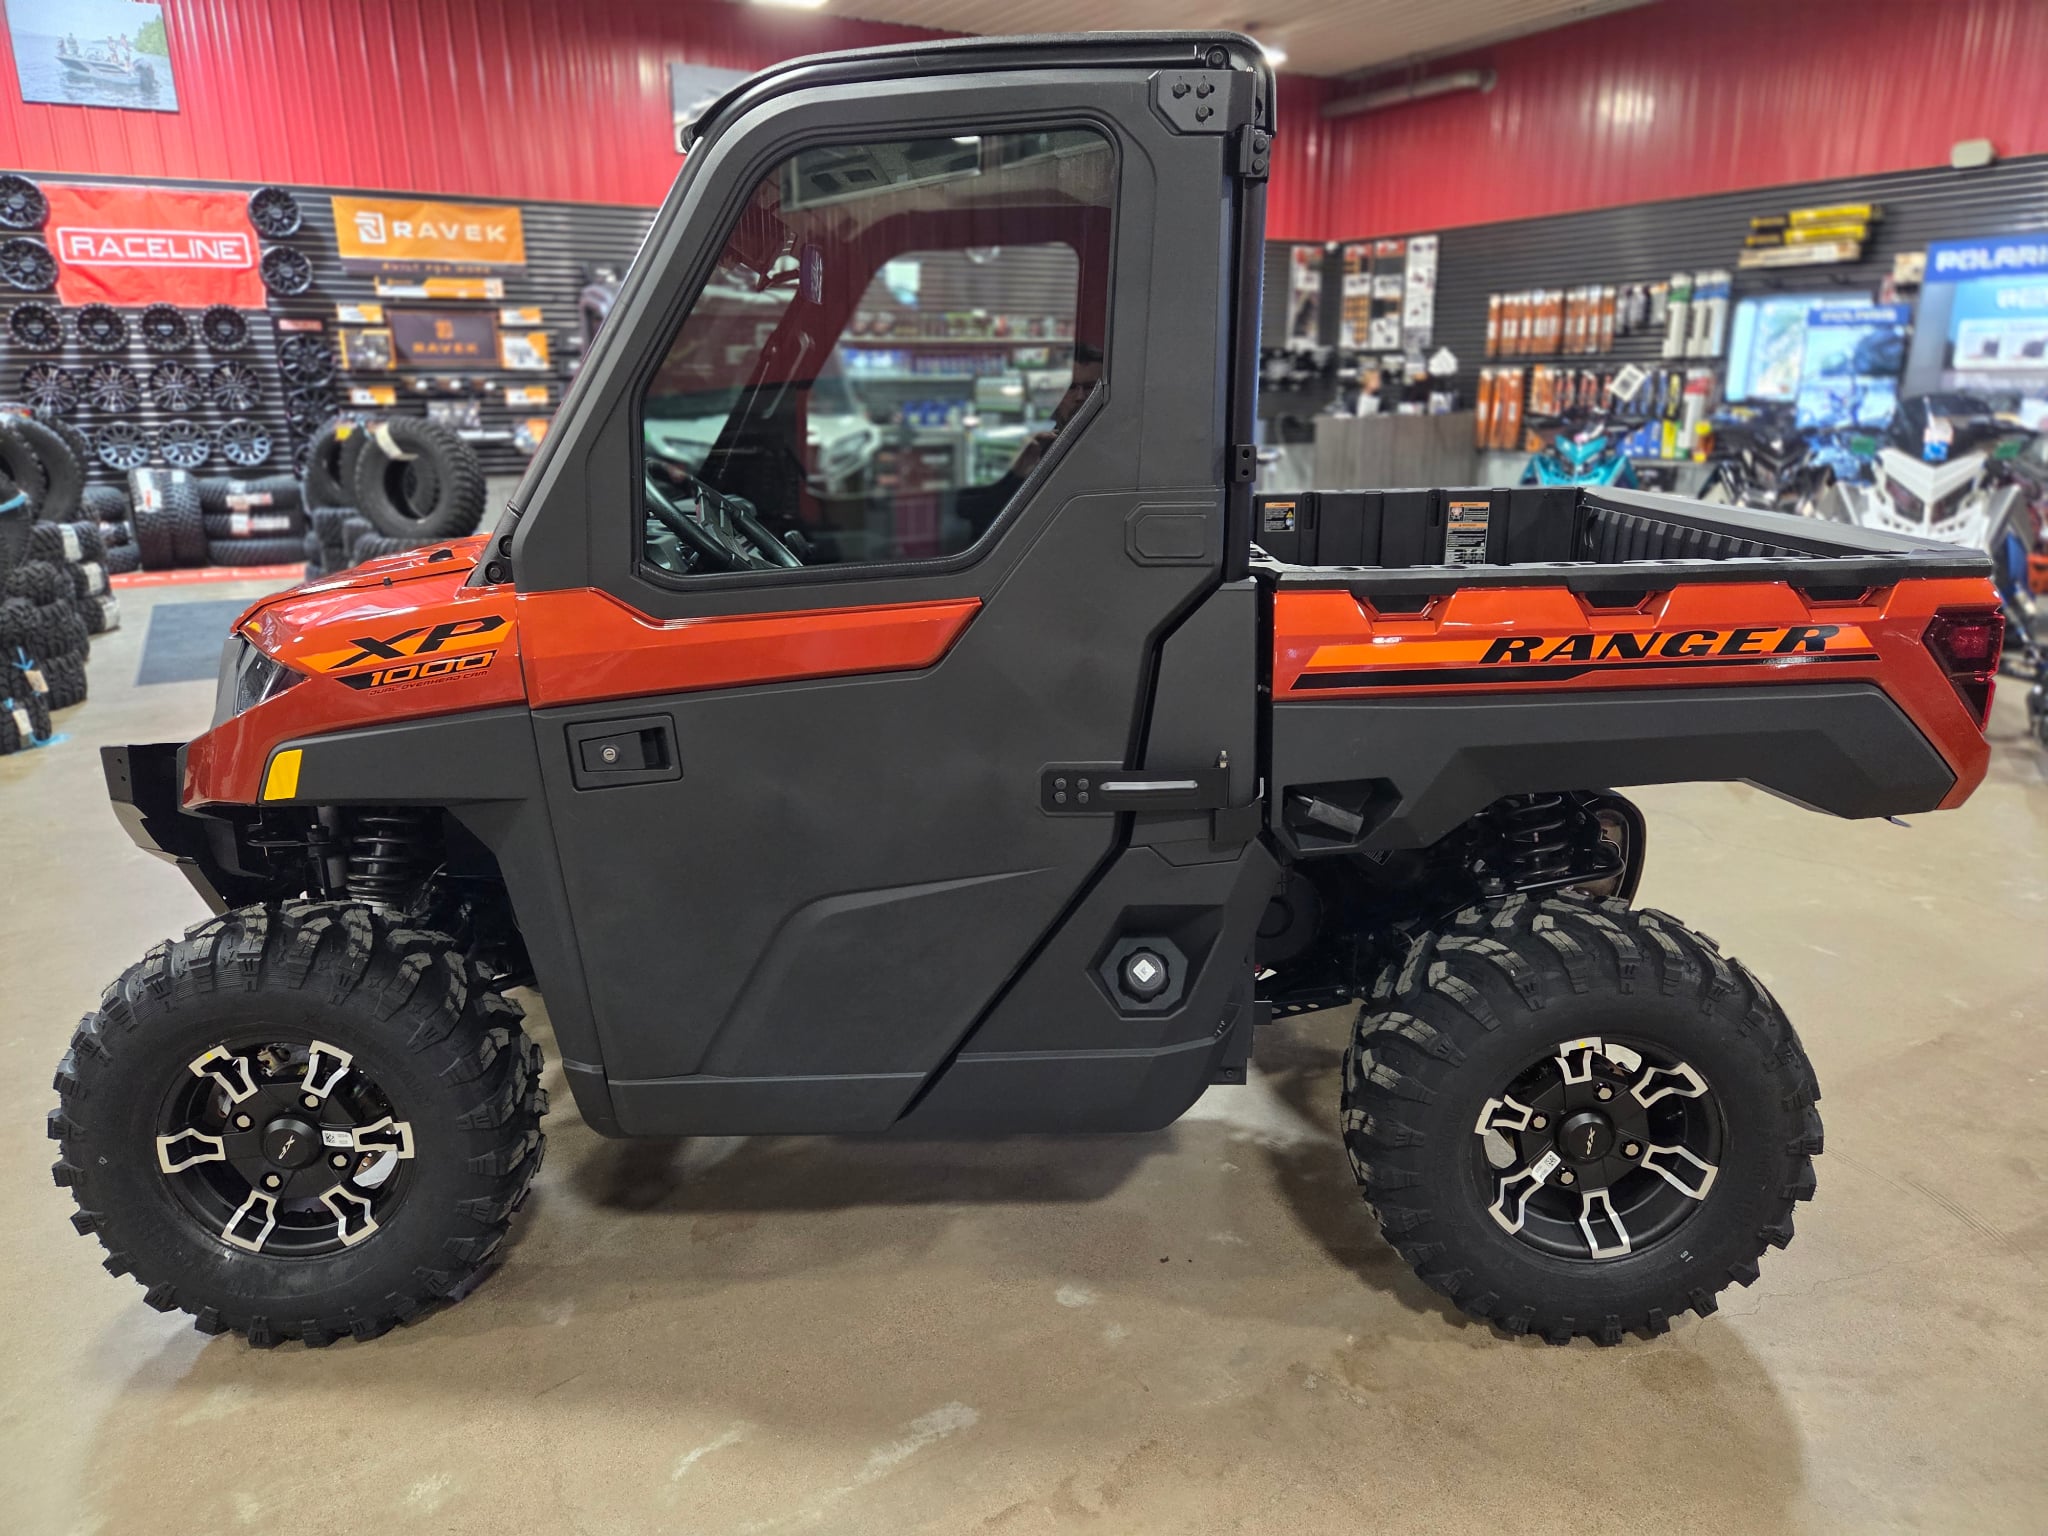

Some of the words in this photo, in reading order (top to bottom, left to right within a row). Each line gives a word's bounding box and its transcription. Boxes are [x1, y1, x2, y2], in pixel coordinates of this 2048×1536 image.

[392, 221, 507, 243] RAVEK
[70, 236, 242, 260] RACELINE
[412, 342, 477, 354] RAVEK
[327, 615, 506, 670] XP
[1479, 625, 1840, 664] RANGER
[370, 652, 494, 686] 1000
[369, 686, 399, 696] DUAL
[401, 676, 461, 690] OVERHEAD
[463, 670, 488, 681] CAM
